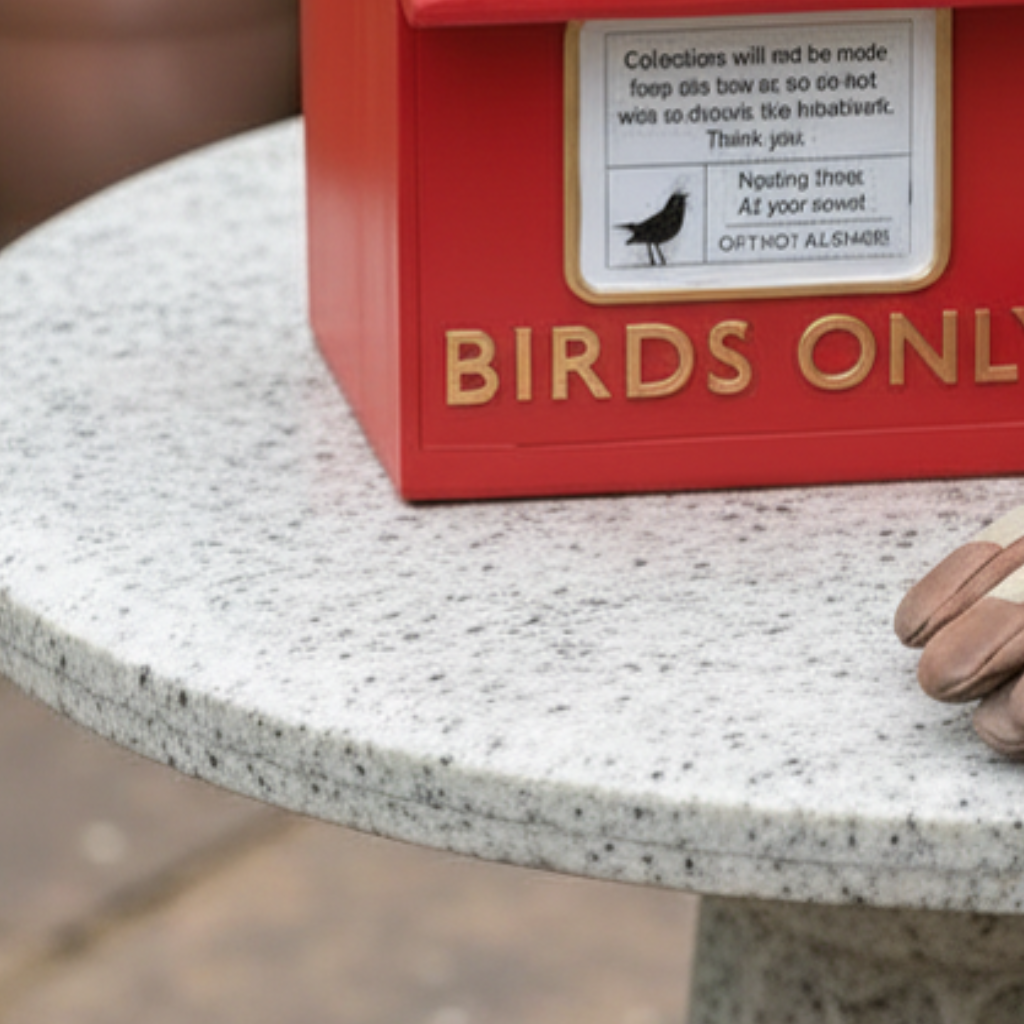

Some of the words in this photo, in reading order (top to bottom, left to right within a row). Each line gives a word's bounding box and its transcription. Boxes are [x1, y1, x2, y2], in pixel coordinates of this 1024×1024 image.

[733, 46, 766, 66] will
[808, 43, 832, 64] be
[445, 320, 753, 406] BIRDS
